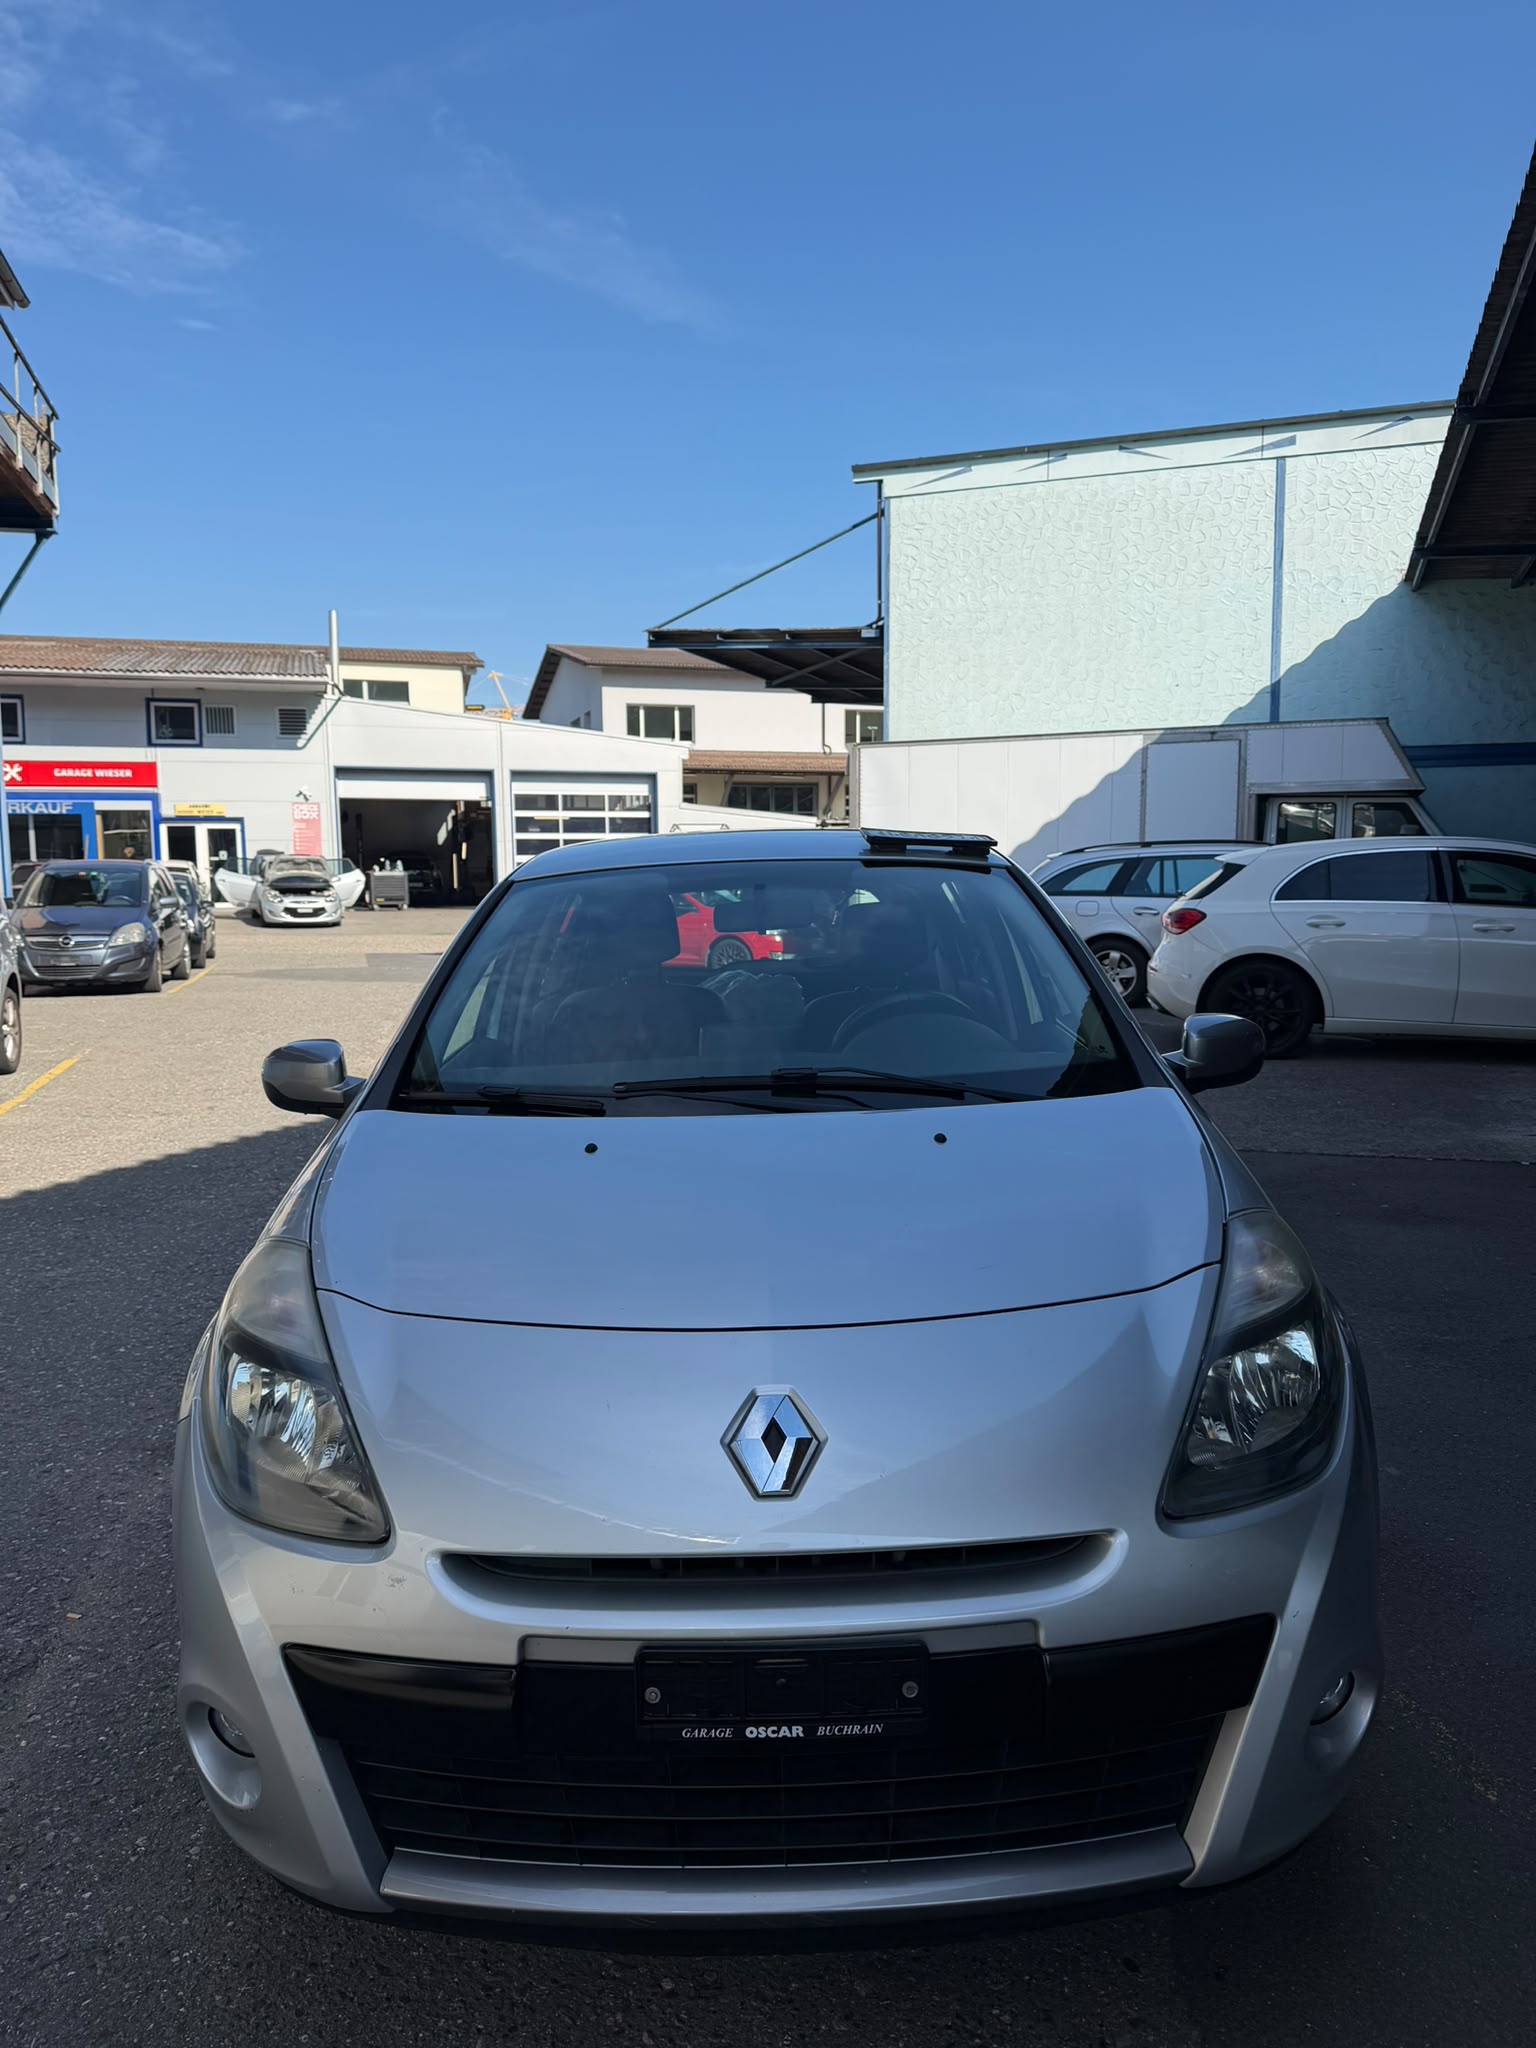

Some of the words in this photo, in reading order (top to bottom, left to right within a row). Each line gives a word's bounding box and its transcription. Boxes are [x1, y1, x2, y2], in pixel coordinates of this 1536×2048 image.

[53, 768, 93, 778] GARAGE
[94, 769, 133, 778] WIESER
[681, 1727, 734, 1739] GARAGE
[745, 1726, 804, 1738] OSCAR
[816, 1723, 884, 1736] BUCHRAIN
